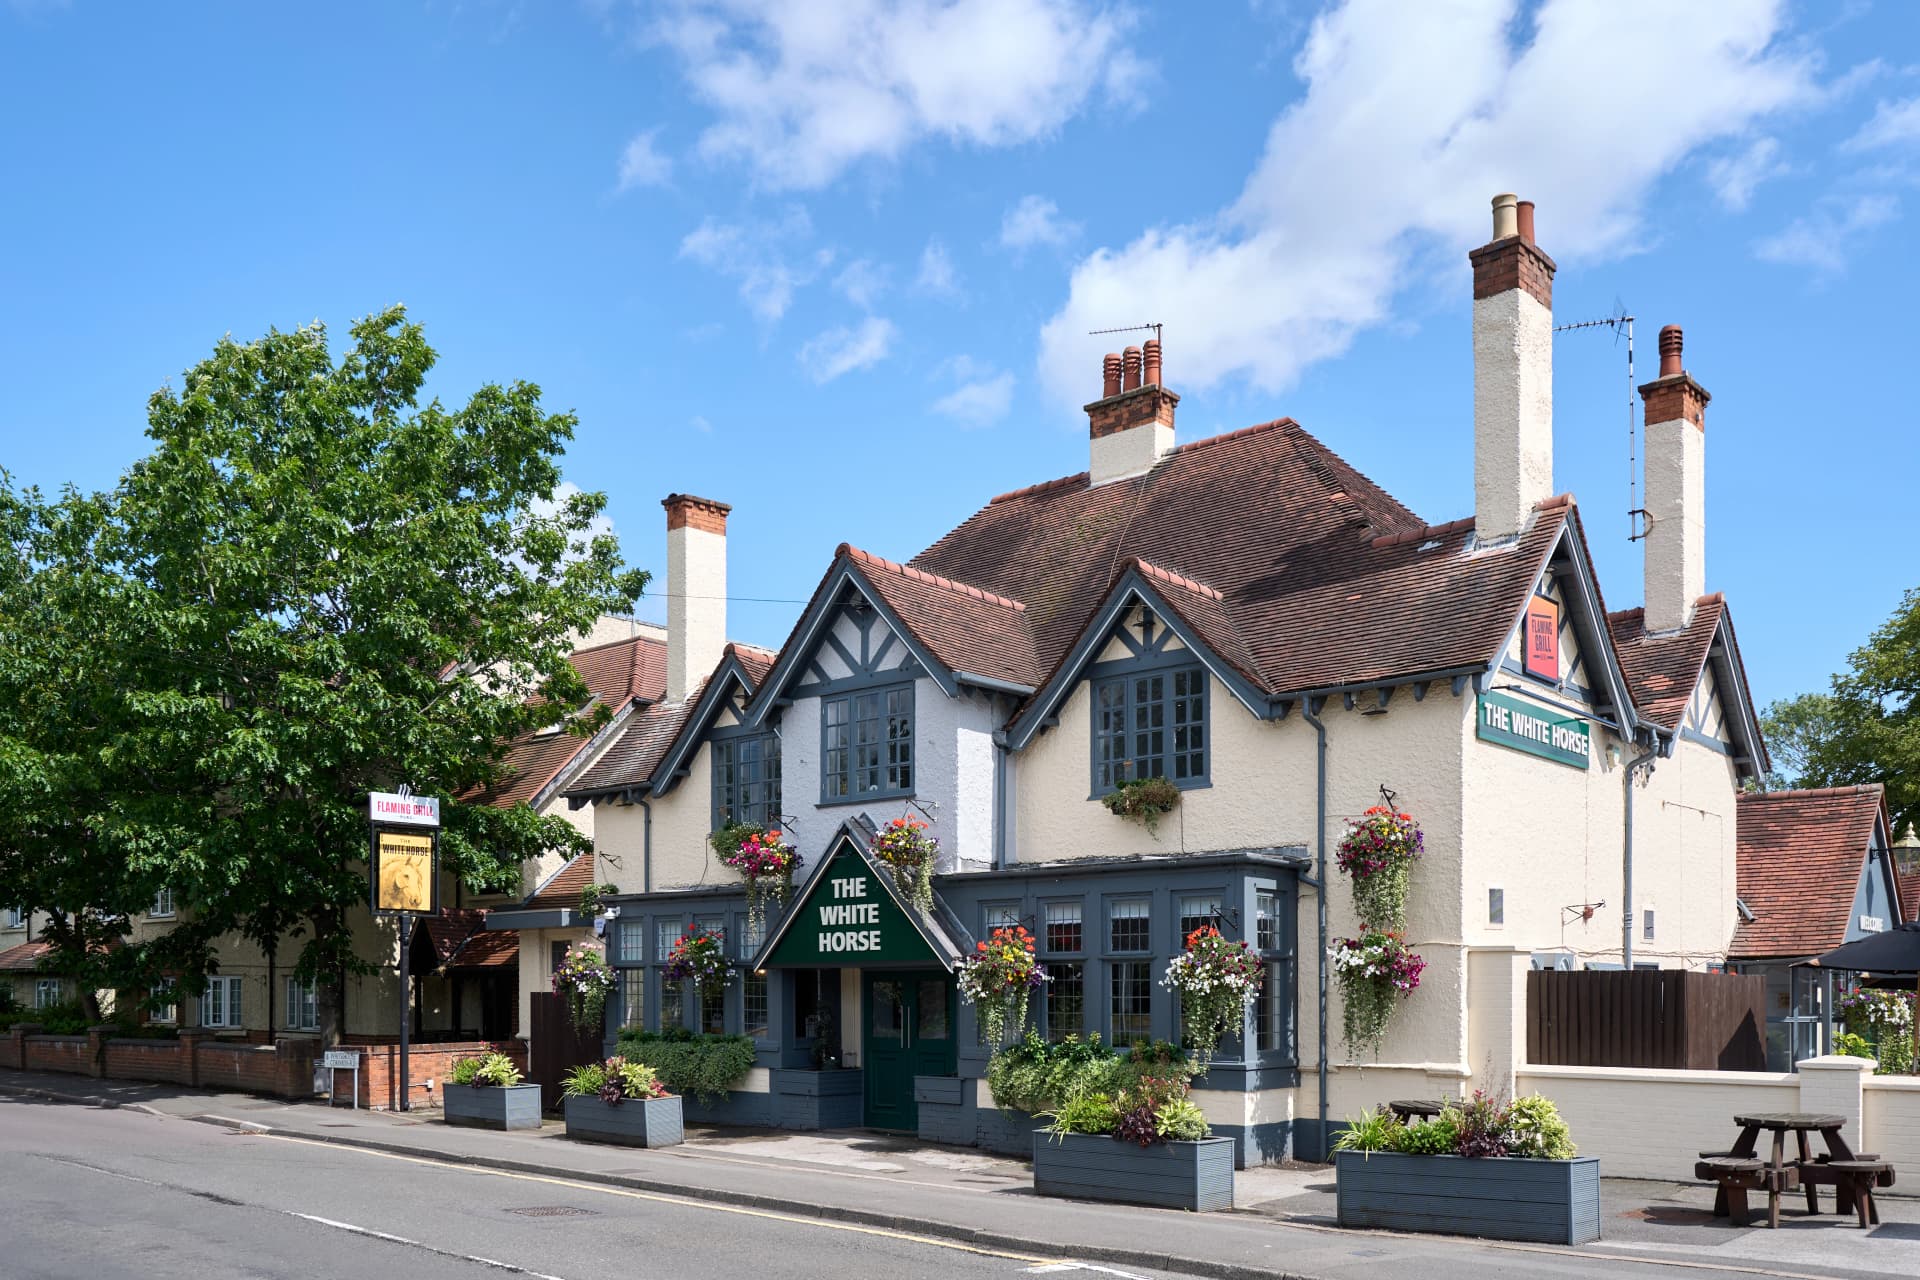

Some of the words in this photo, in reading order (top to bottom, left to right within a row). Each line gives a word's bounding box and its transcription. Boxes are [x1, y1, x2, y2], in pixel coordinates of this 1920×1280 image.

[1531, 618, 1553, 635] FLAMING
[1535, 634, 1552, 653] GRILL
[1483, 701, 1509, 731] THE
[1511, 711, 1550, 745] WHITE
[1551, 724, 1589, 756] HORSE
[377, 800, 411, 815] FLAMING
[413, 804, 434, 817] GRILL
[382, 843, 405, 855] WHITE
[405, 845, 430, 857] HORSE
[831, 877, 867, 899] THE
[819, 903, 880, 926] WHITE
[818, 930, 882, 953] HORSE
